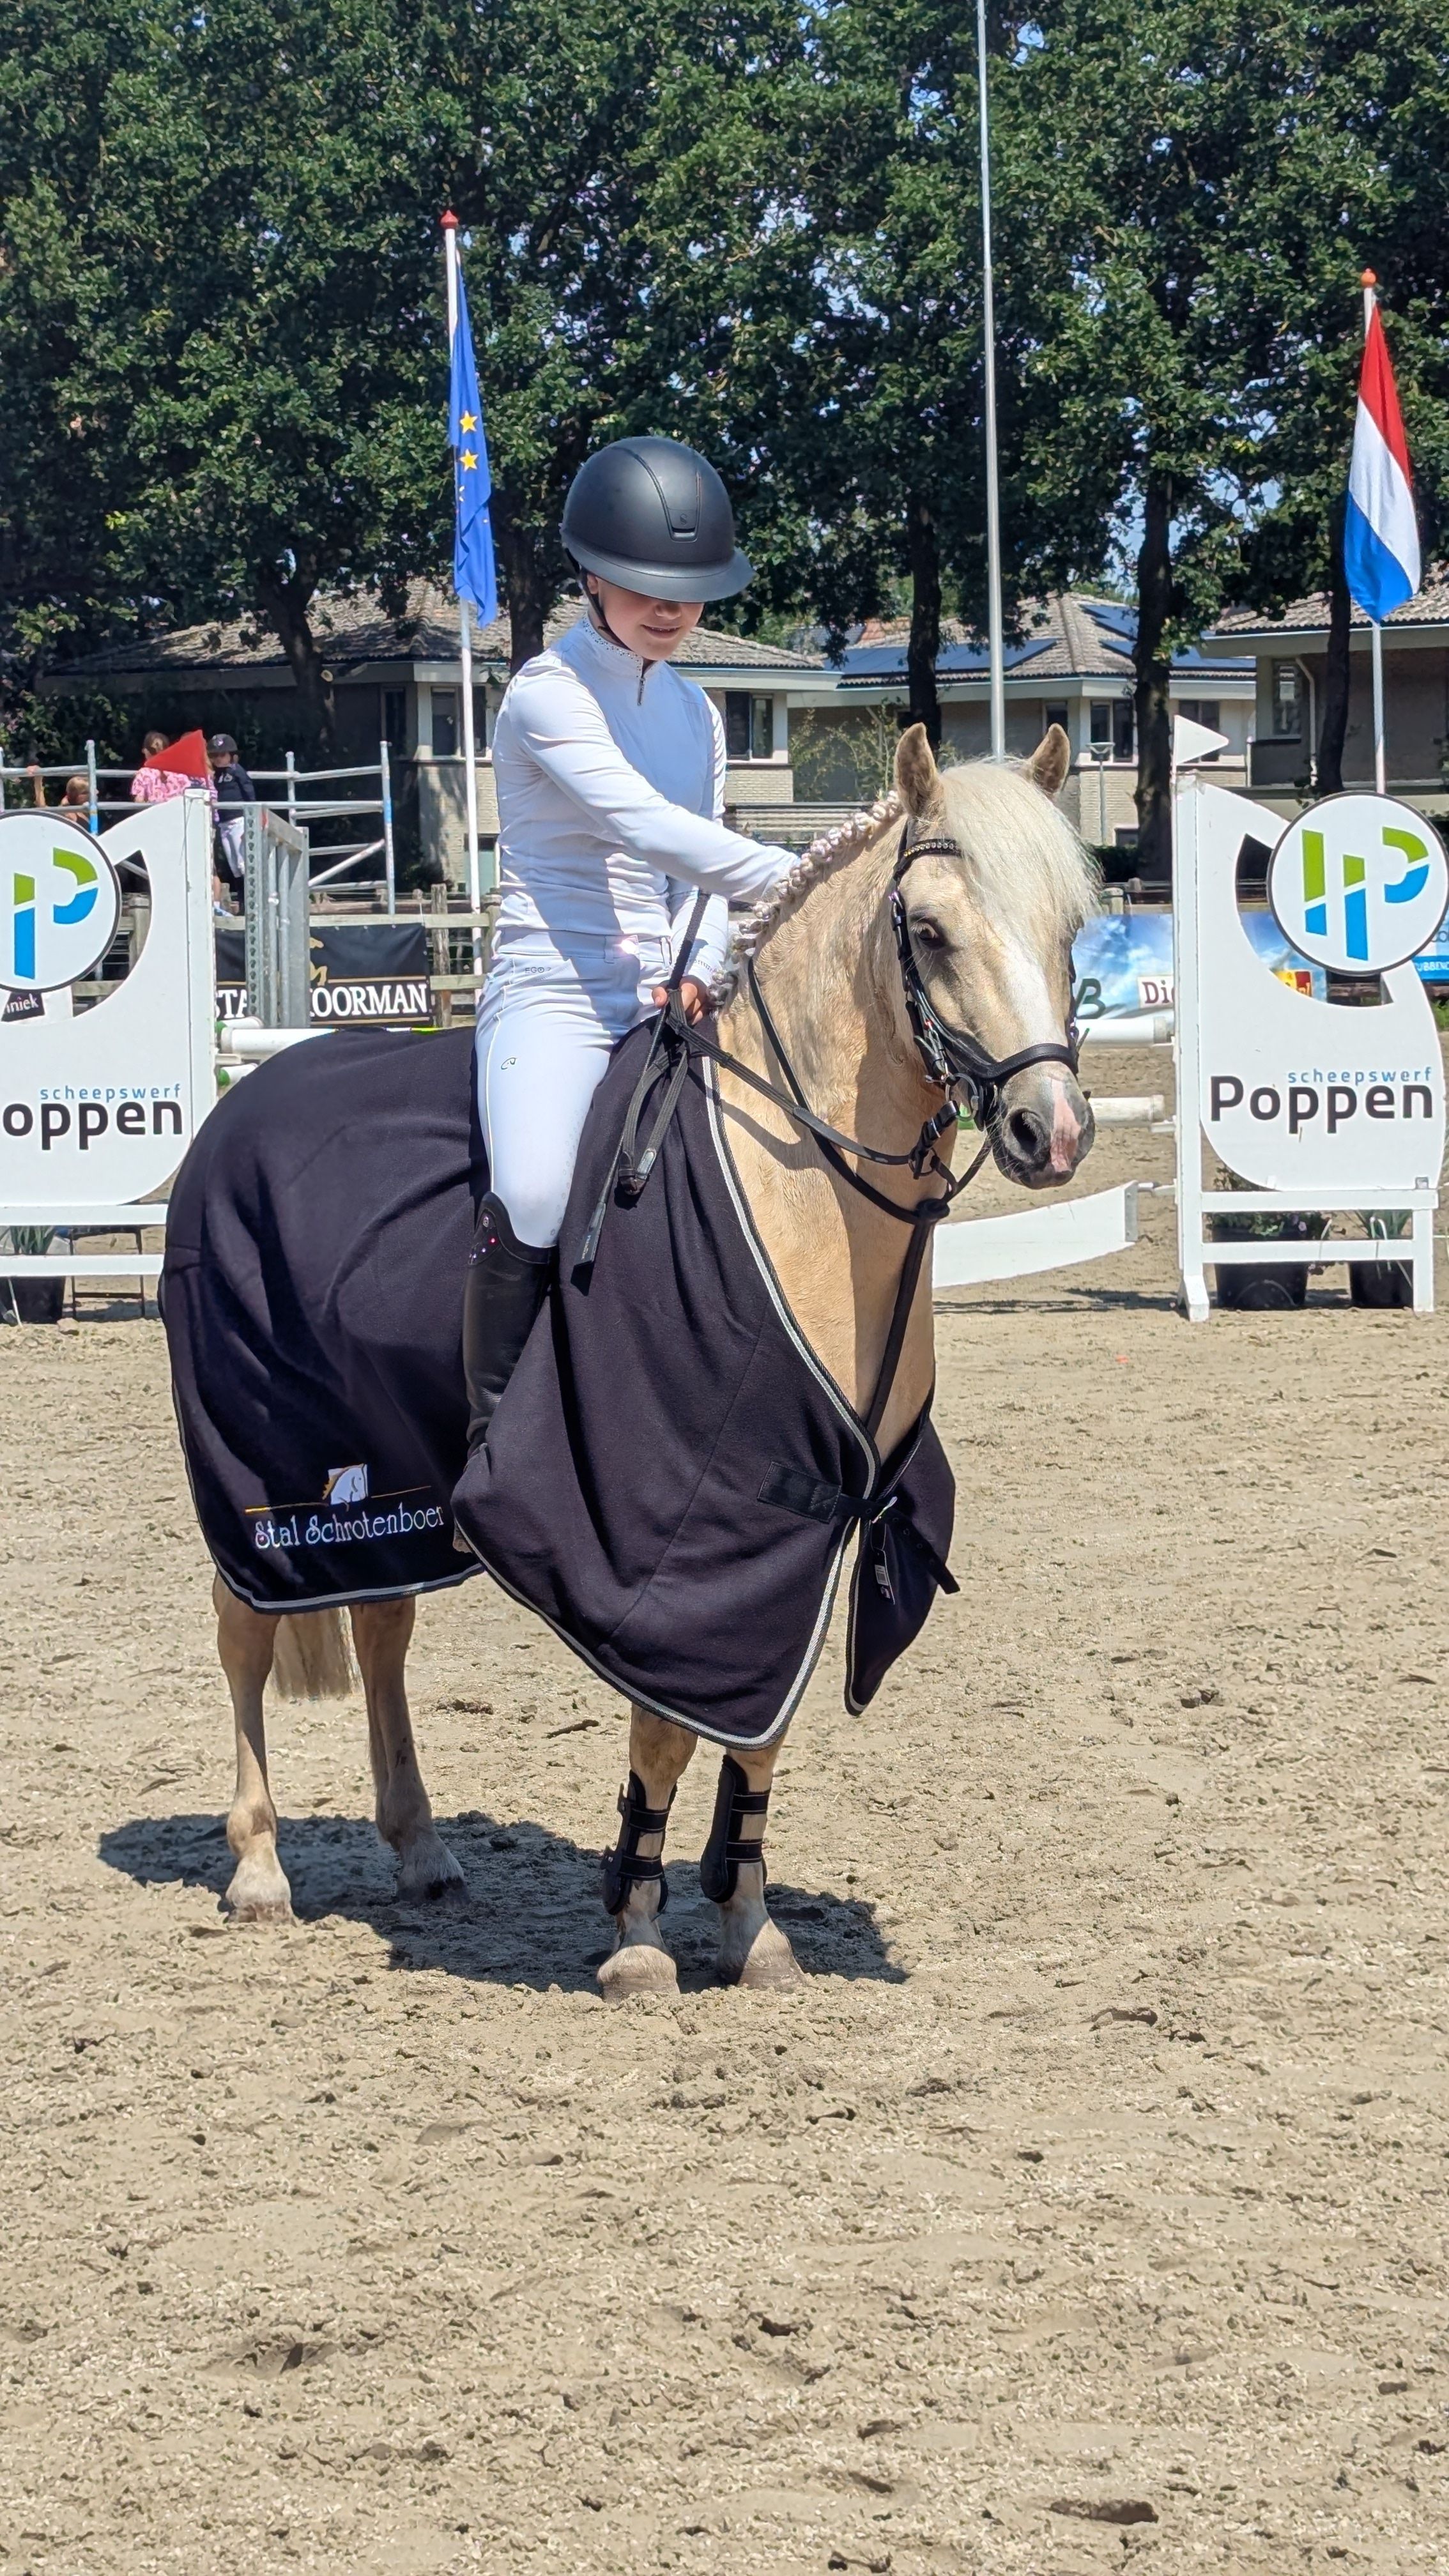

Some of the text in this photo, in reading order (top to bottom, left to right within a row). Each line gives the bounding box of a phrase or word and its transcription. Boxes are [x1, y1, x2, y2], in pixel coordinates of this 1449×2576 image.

[309, 983, 428, 1017] OORMAN
[1287, 1066, 1432, 1085] scheepswerf
[40, 1083, 181, 1103] scheepswerf
[1211, 1075, 1433, 1134] Poppen
[255, 1502, 445, 1549] Stal Schrotenboer
